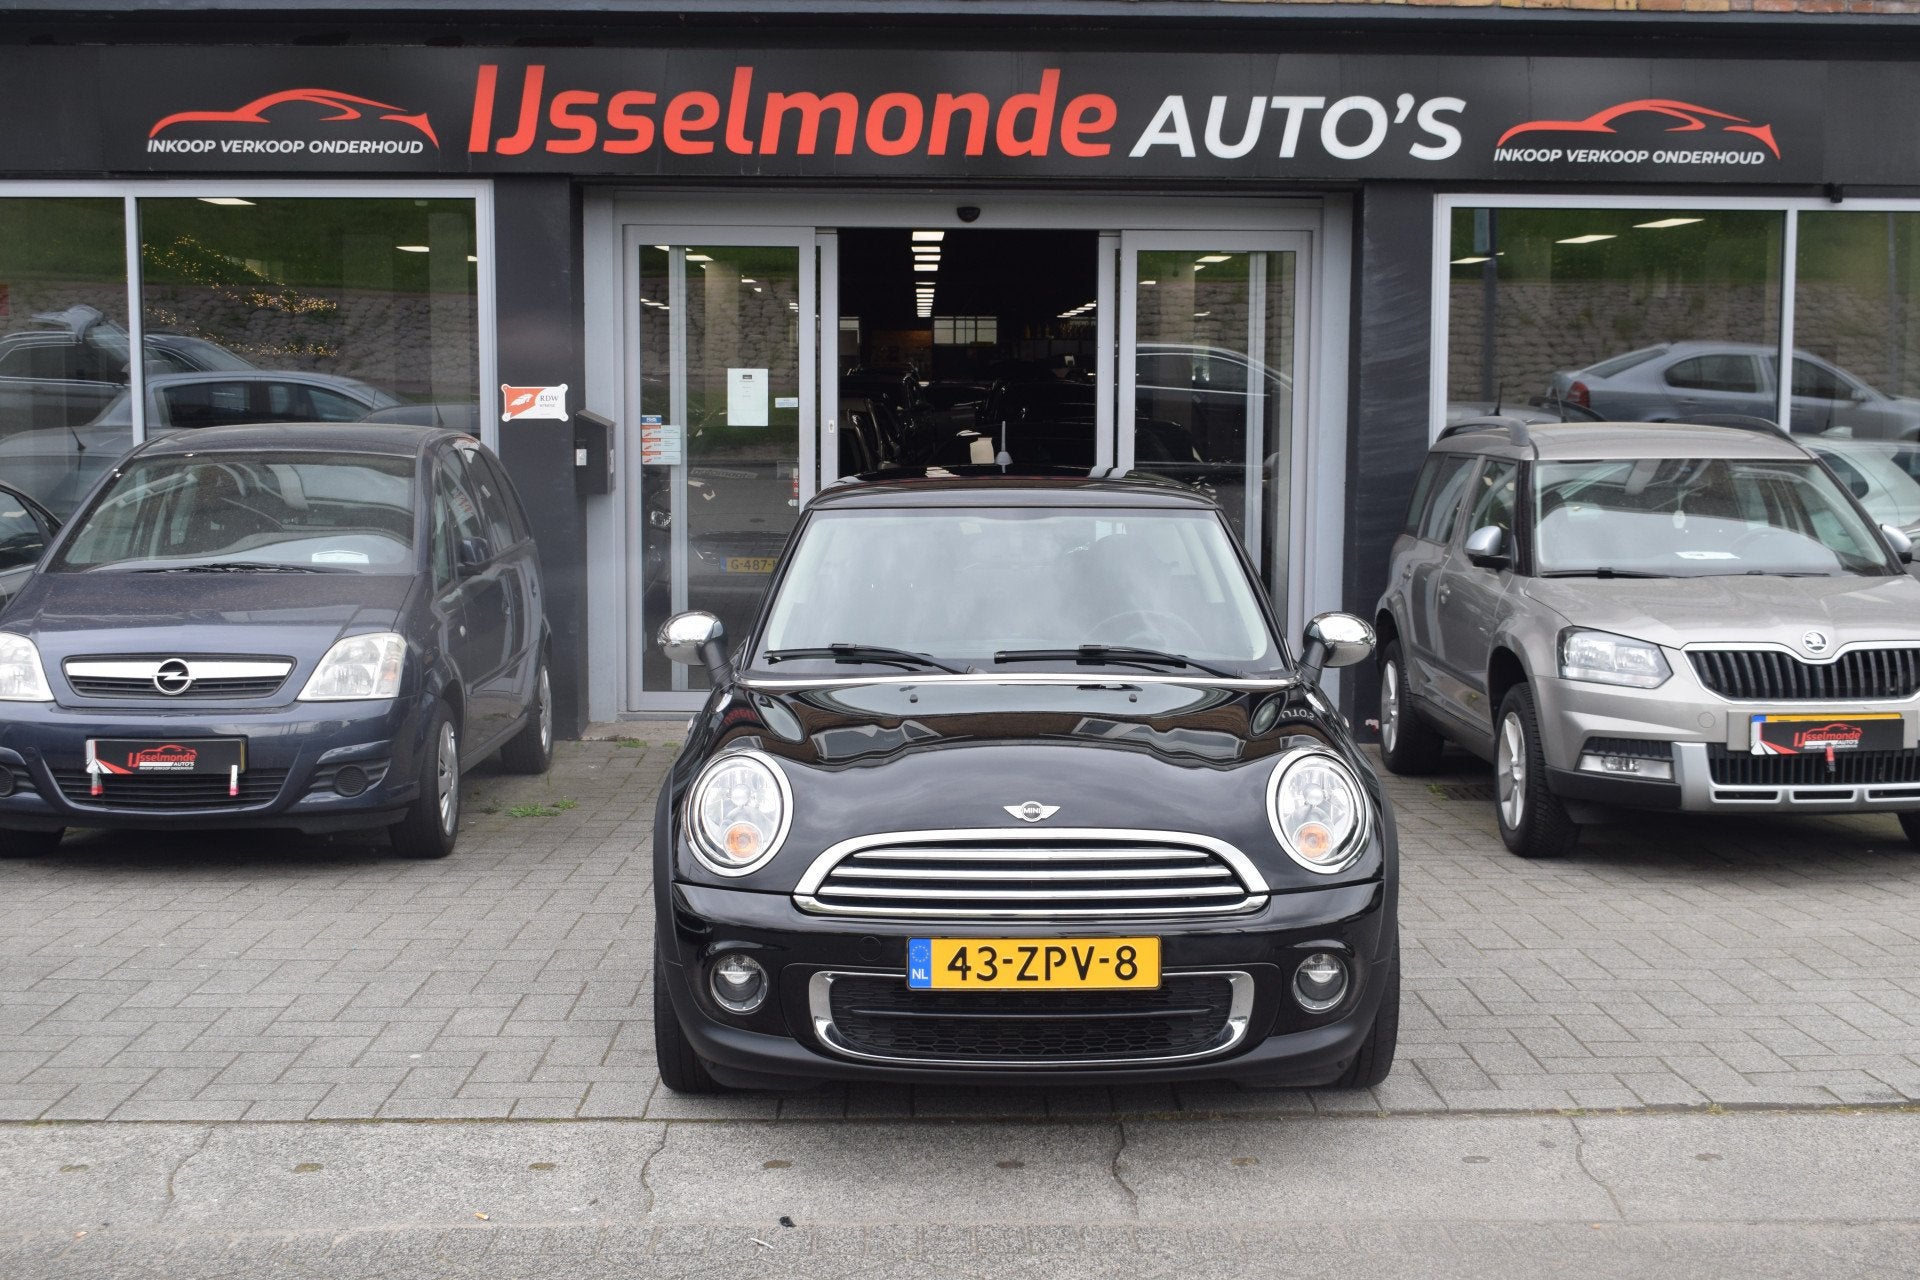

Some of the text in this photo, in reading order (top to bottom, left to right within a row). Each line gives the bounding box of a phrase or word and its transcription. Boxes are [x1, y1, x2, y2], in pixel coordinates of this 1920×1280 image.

[468, 64, 1467, 161] IJsselmonde AUTO'S
[147, 139, 424, 154] INKOOP VERKOOP ONDERHOUD
[1493, 148, 1765, 165] INKOOP VERKOOP ONDERHOUD
[1794, 731, 1860, 747] IJsselmonde
[128, 752, 195, 767] IJsselmonde
[947, 945, 1138, 982] 43-ZPV-8
[912, 968, 929, 980] NL
